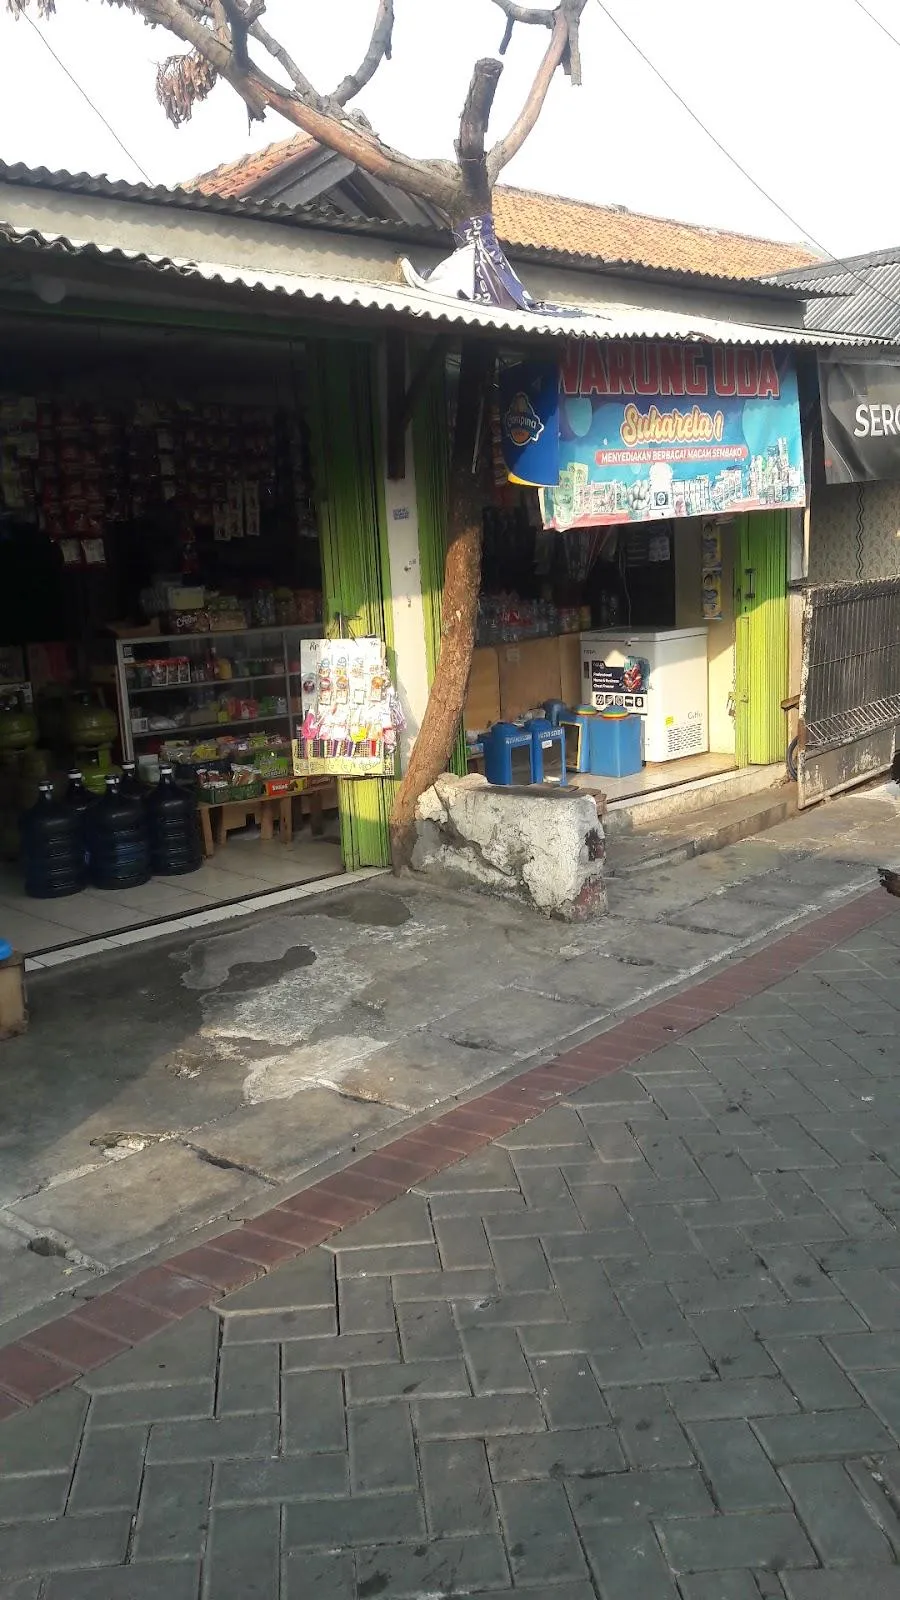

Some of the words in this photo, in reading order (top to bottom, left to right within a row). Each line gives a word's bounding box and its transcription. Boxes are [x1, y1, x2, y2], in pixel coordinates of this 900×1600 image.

[712, 347, 780, 398] UDA
[620, 403, 713, 447] Sukarela
[601, 451, 651, 464] MENYEDIAKAN
[652, 449, 686, 461] BERBAGAI
[687, 448, 711, 460] MACAM
[711, 447, 742, 458] SEMBAKO
